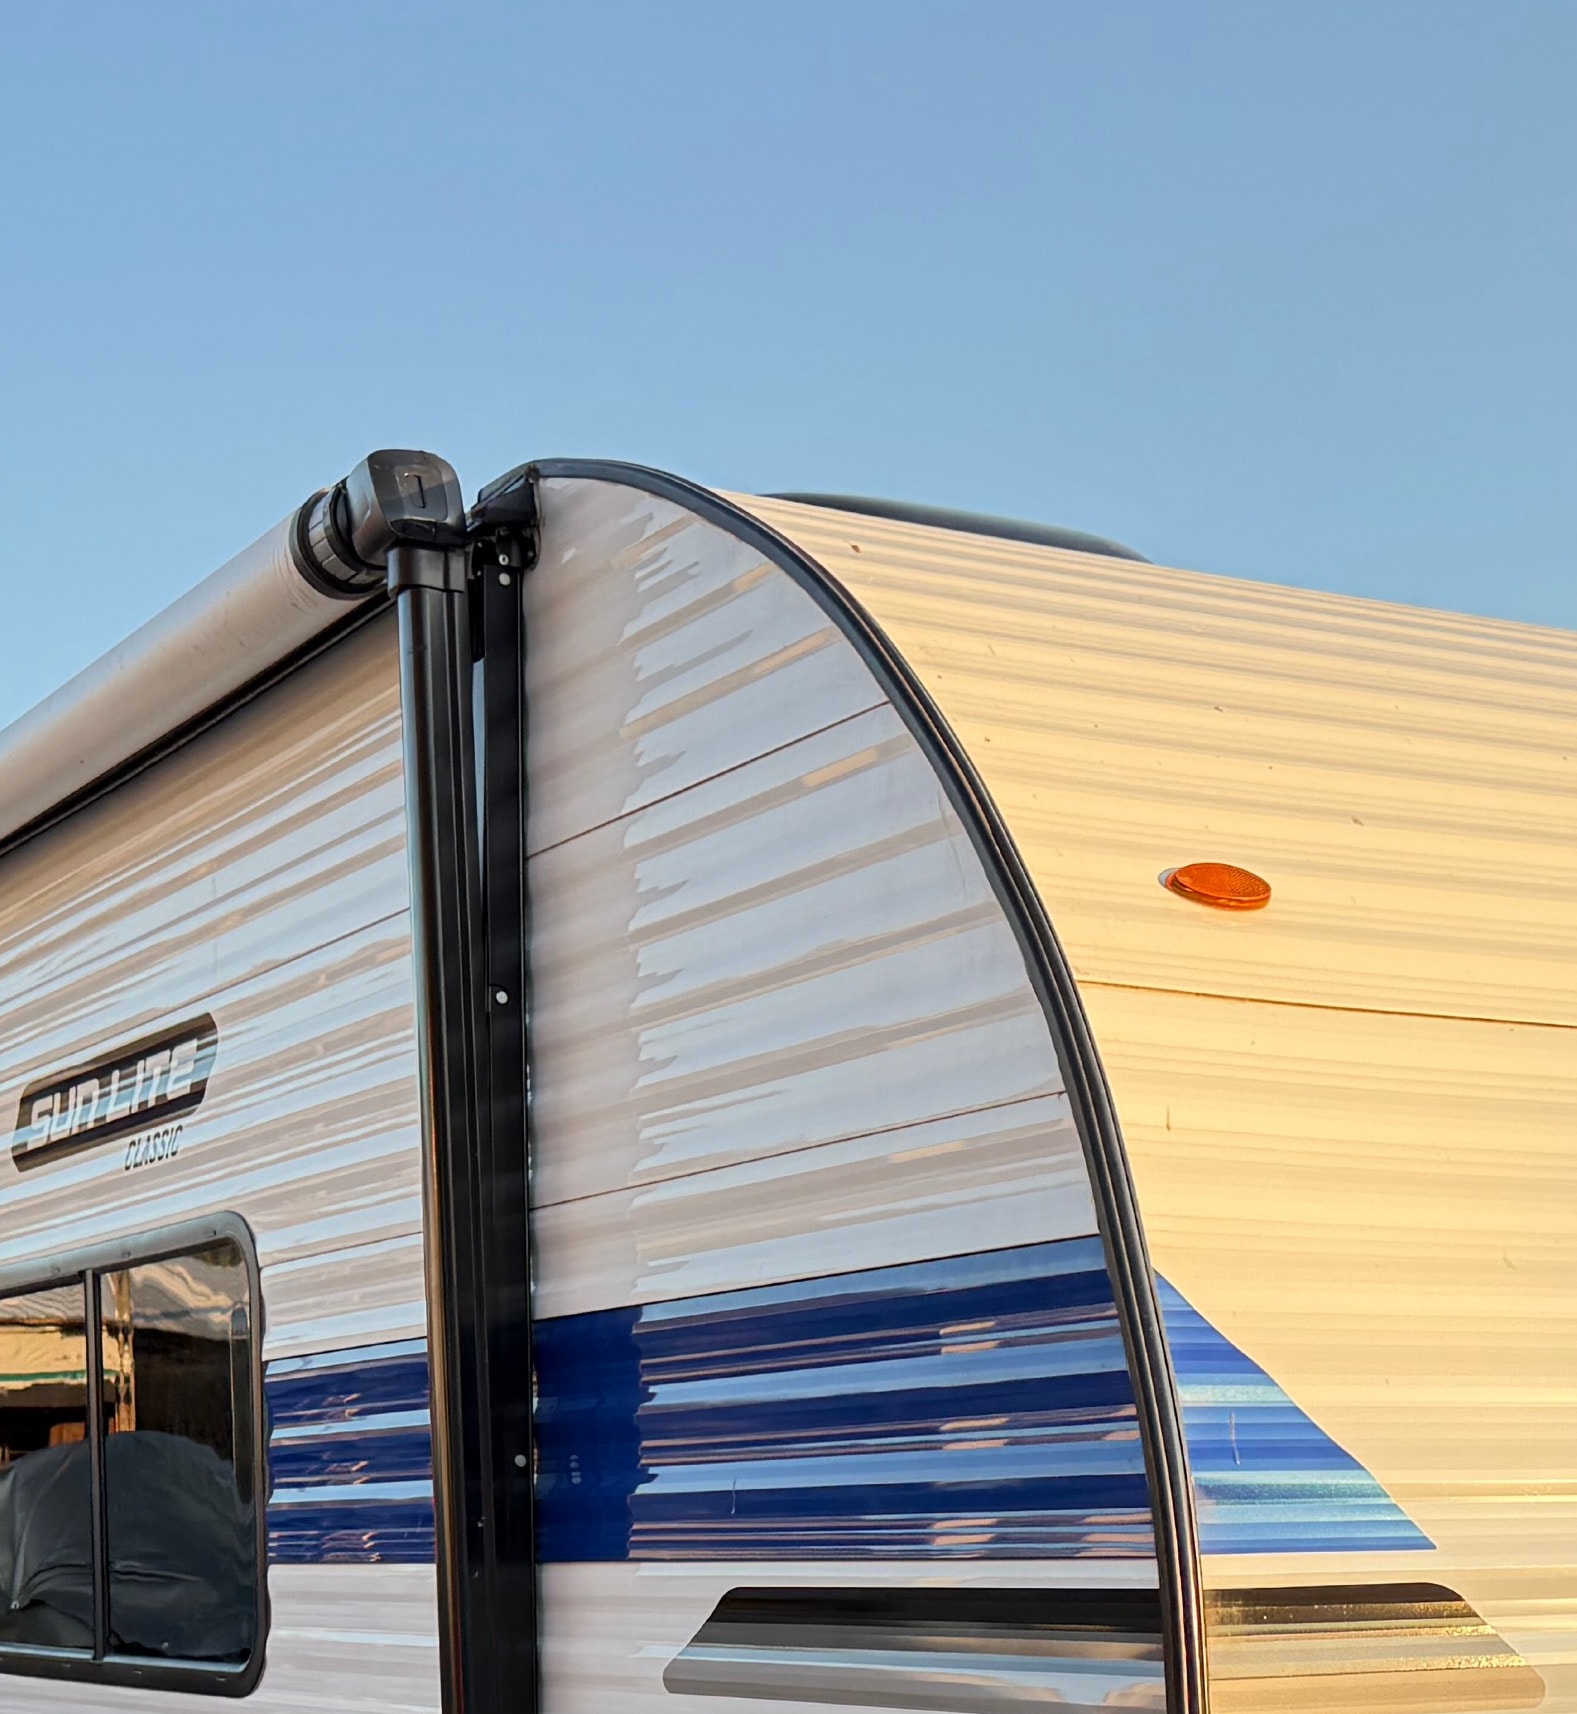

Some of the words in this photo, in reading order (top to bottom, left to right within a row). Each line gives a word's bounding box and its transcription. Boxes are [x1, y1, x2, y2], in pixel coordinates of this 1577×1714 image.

[26, 1078, 100, 1151] SUN
[106, 1038, 198, 1122] LITE
[124, 1125, 184, 1171] CLASSIC
